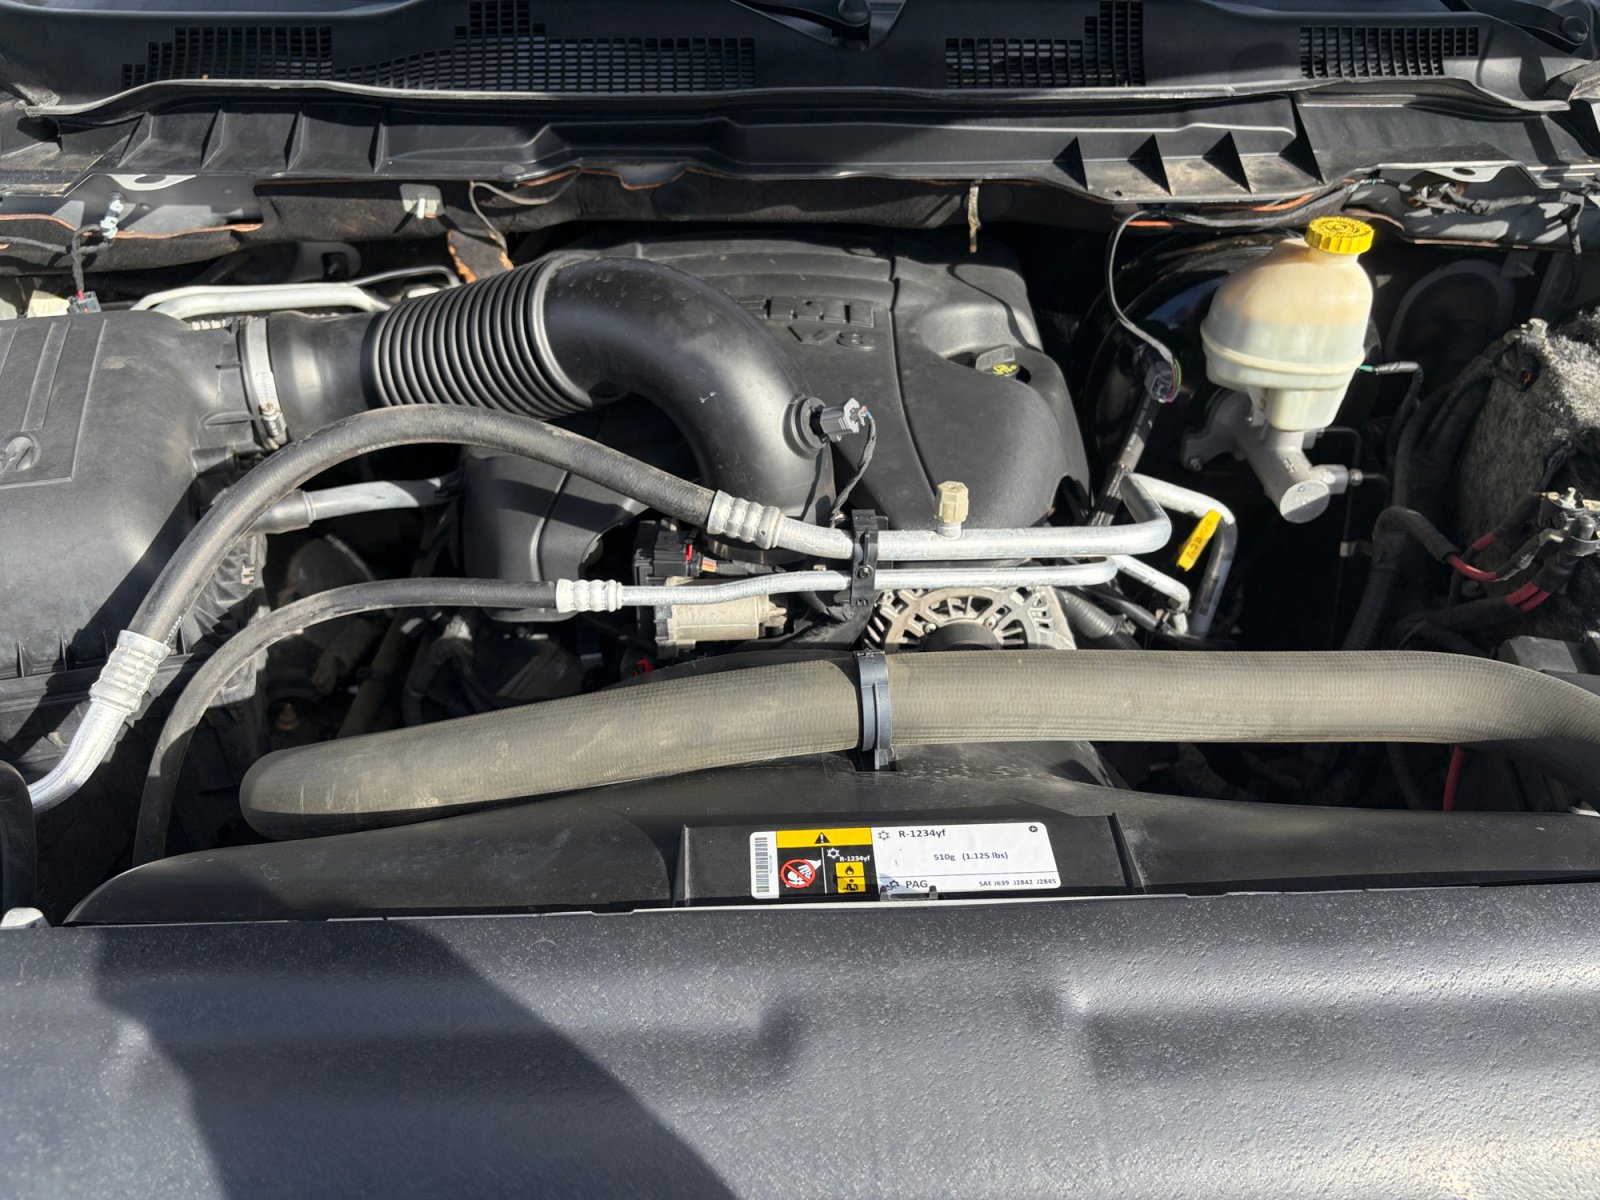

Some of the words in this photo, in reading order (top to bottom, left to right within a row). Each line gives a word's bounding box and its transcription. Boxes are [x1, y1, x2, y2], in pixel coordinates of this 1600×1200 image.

[898, 828, 946, 839] R-1234yf
[839, 855, 871, 863] R-1234yf
[933, 853, 956, 862] 510g
[962, 852, 990, 861] (1.125
[992, 851, 1009, 860] lbs)
[905, 879, 929, 889] PAG
